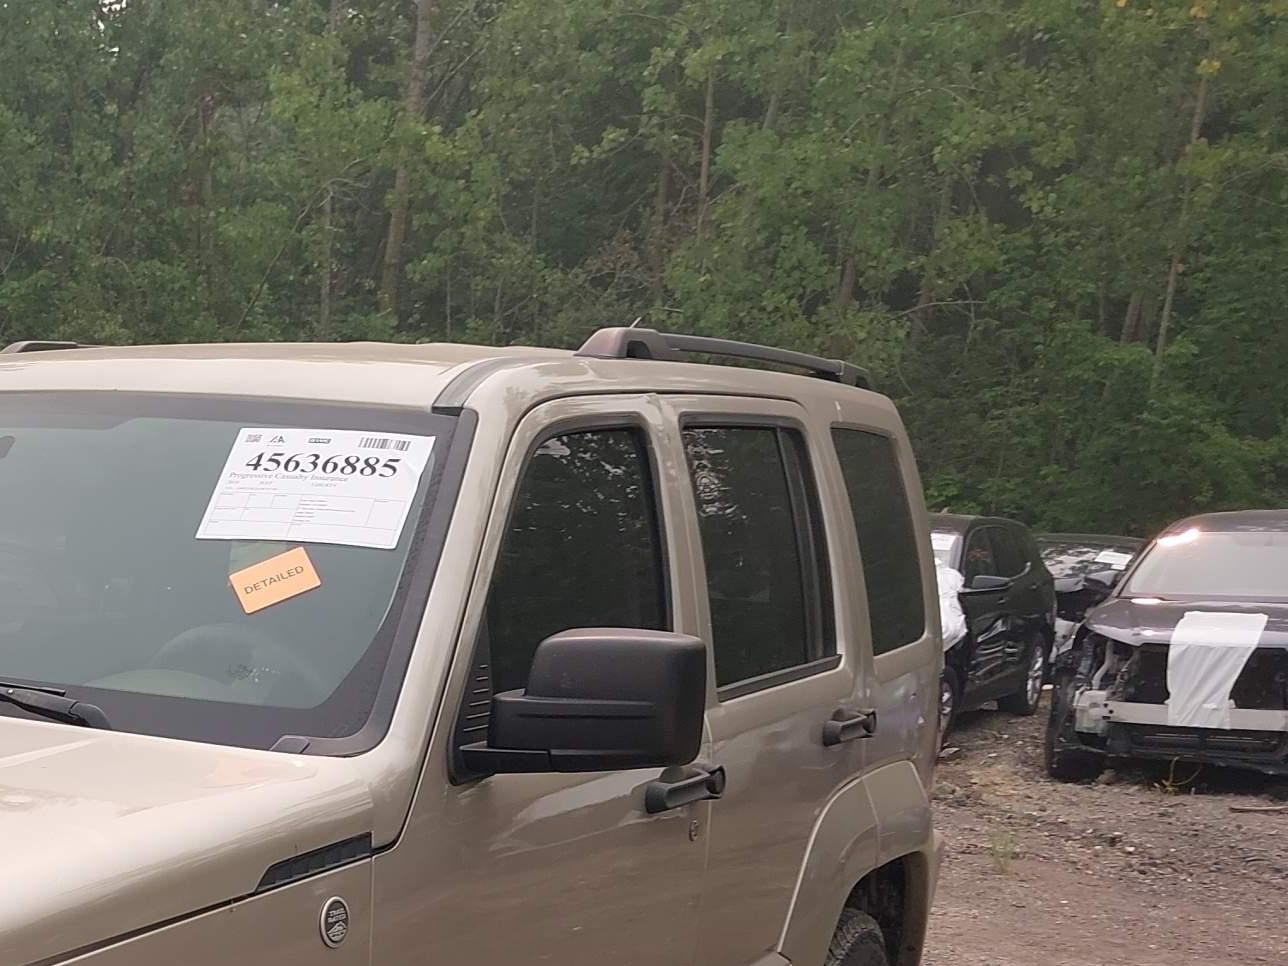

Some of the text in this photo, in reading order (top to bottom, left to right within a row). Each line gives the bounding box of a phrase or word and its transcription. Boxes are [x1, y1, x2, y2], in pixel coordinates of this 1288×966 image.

[229, 472, 273, 480] Progressive
[274, 473, 308, 481] Casualty
[245, 452, 401, 477] 45636885
[244, 566, 304, 594] DETAILED
